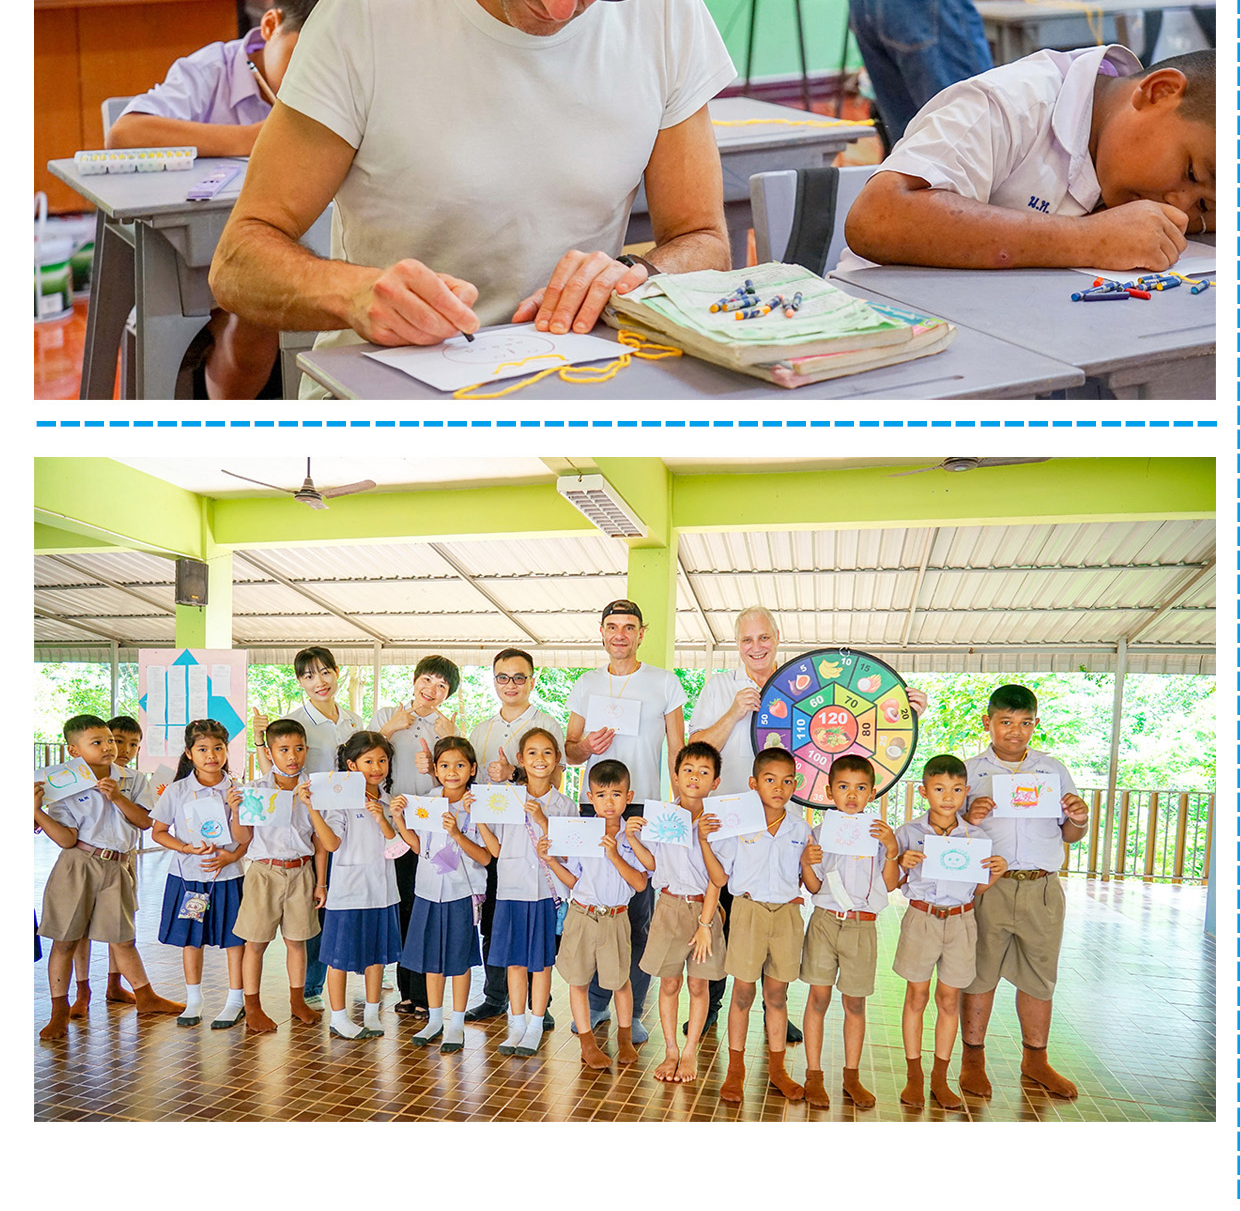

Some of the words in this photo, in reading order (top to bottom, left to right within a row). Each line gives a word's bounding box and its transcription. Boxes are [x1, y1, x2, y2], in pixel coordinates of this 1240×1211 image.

[841, 657, 852, 666] 10
[860, 662, 870, 672] 15
[800, 664, 807, 673] 5
[809, 696, 825, 708] 60
[844, 695, 859, 708] 70
[761, 714, 768, 725] 50
[818, 712, 848, 725] 120
[901, 708, 909, 720] 20
[796, 718, 806, 740] 110
[861, 722, 871, 737] 80
[807, 749, 828, 766] 100
[812, 793, 824, 802] 35
